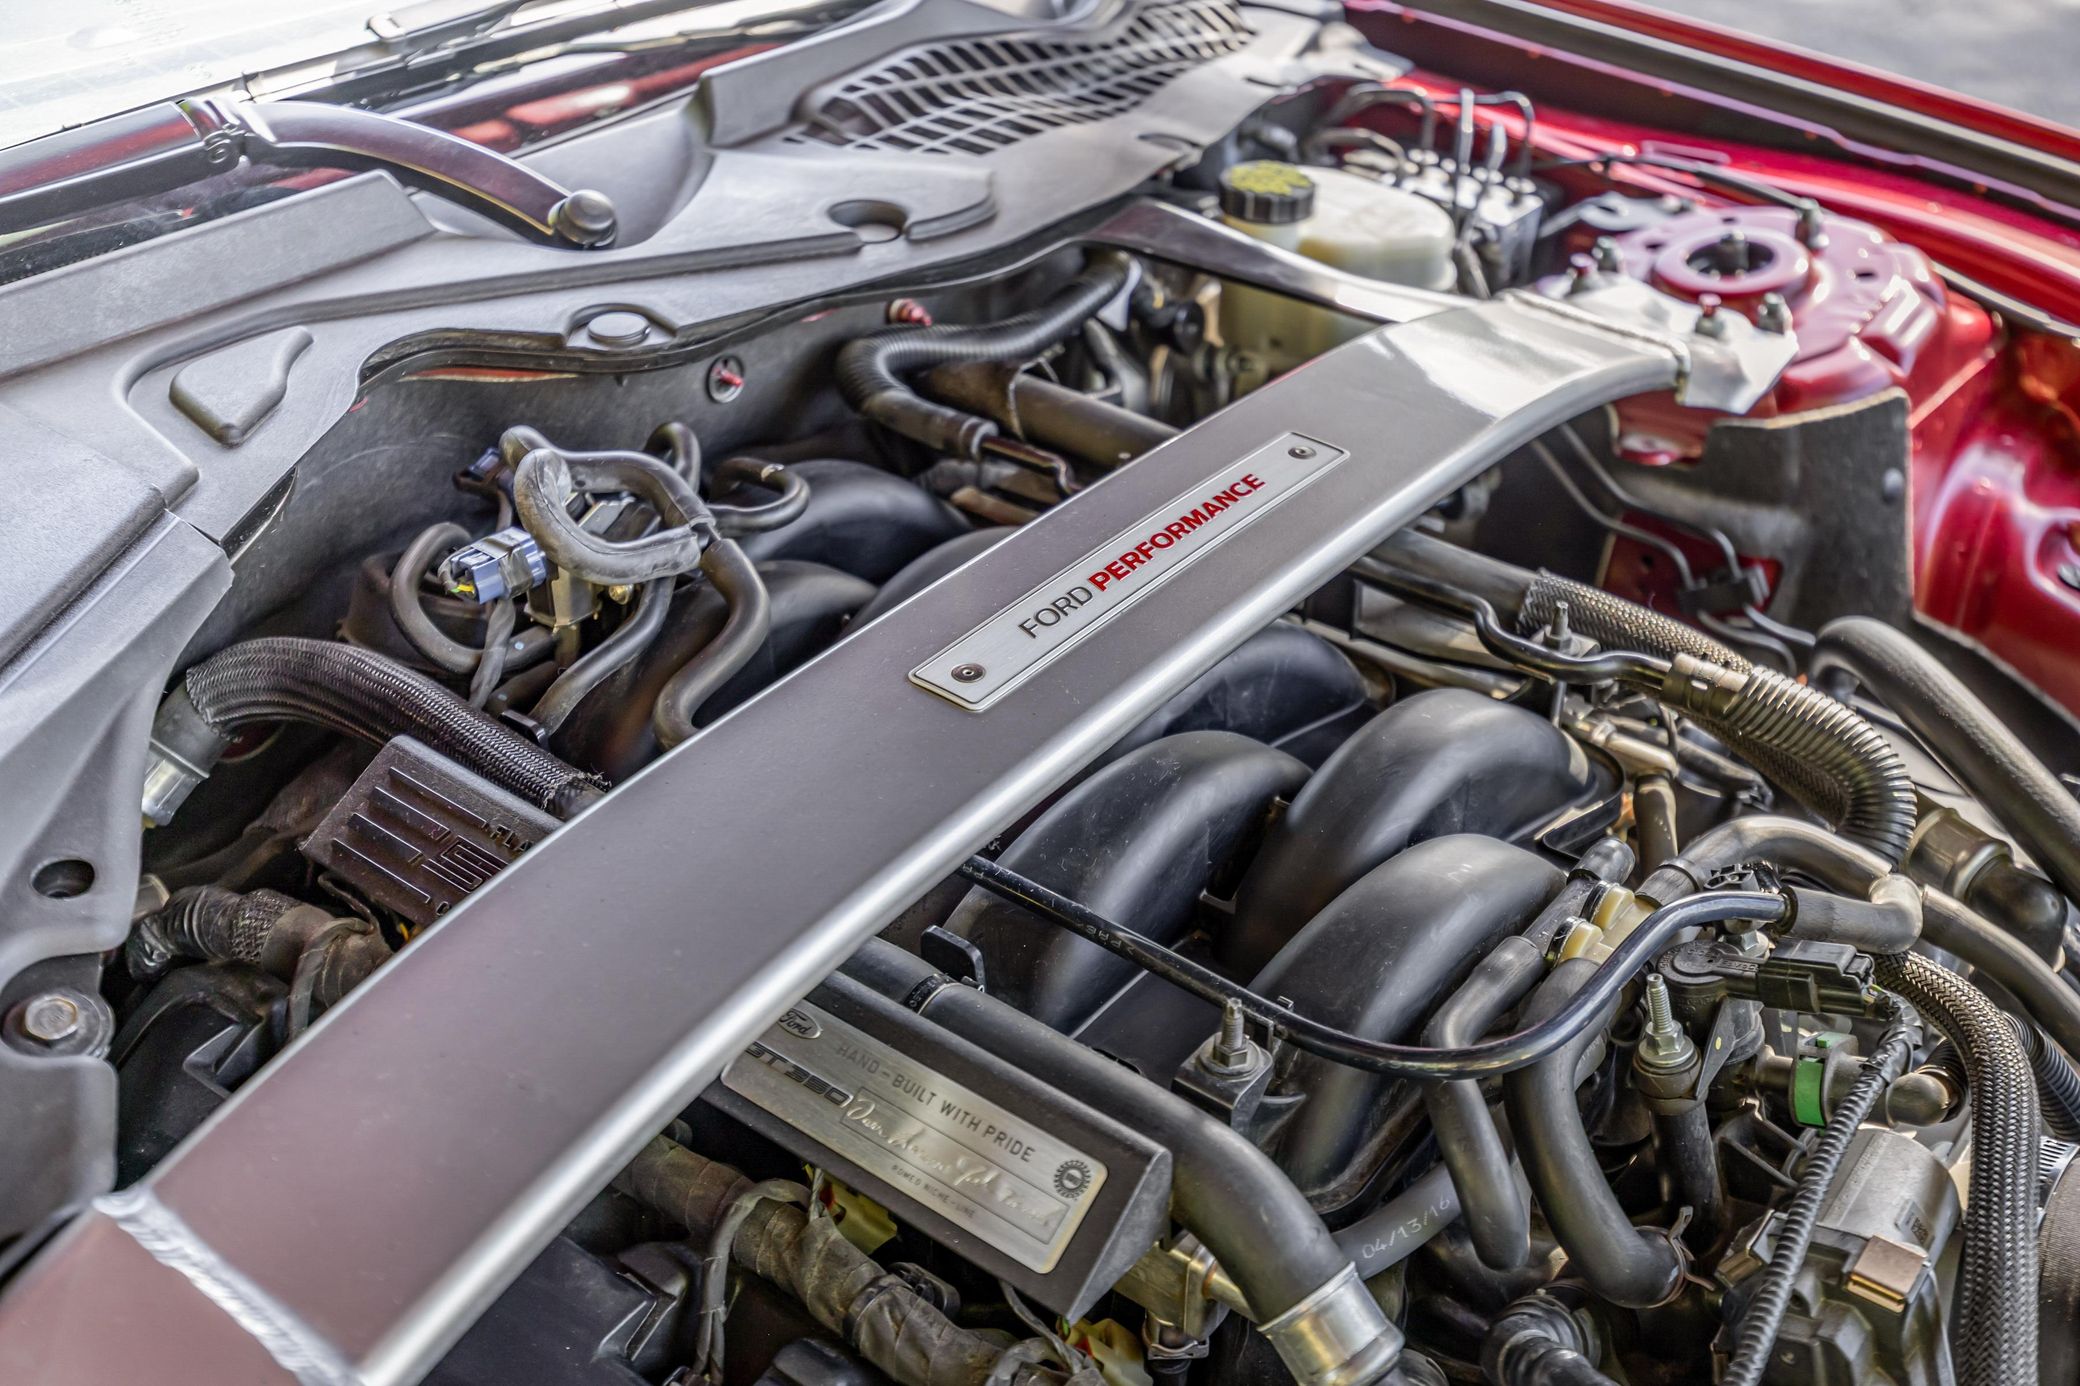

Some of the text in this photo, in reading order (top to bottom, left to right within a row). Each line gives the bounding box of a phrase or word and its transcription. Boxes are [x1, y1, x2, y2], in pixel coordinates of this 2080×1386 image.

[1018, 474, 1266, 639] FORD PERFORMANCE
[779, 1010, 812, 1034] Ford
[940, 1099, 982, 1132] WITH
[982, 1124, 1036, 1163] PRIDE
[1362, 1195, 1450, 1259] 04/13/16
